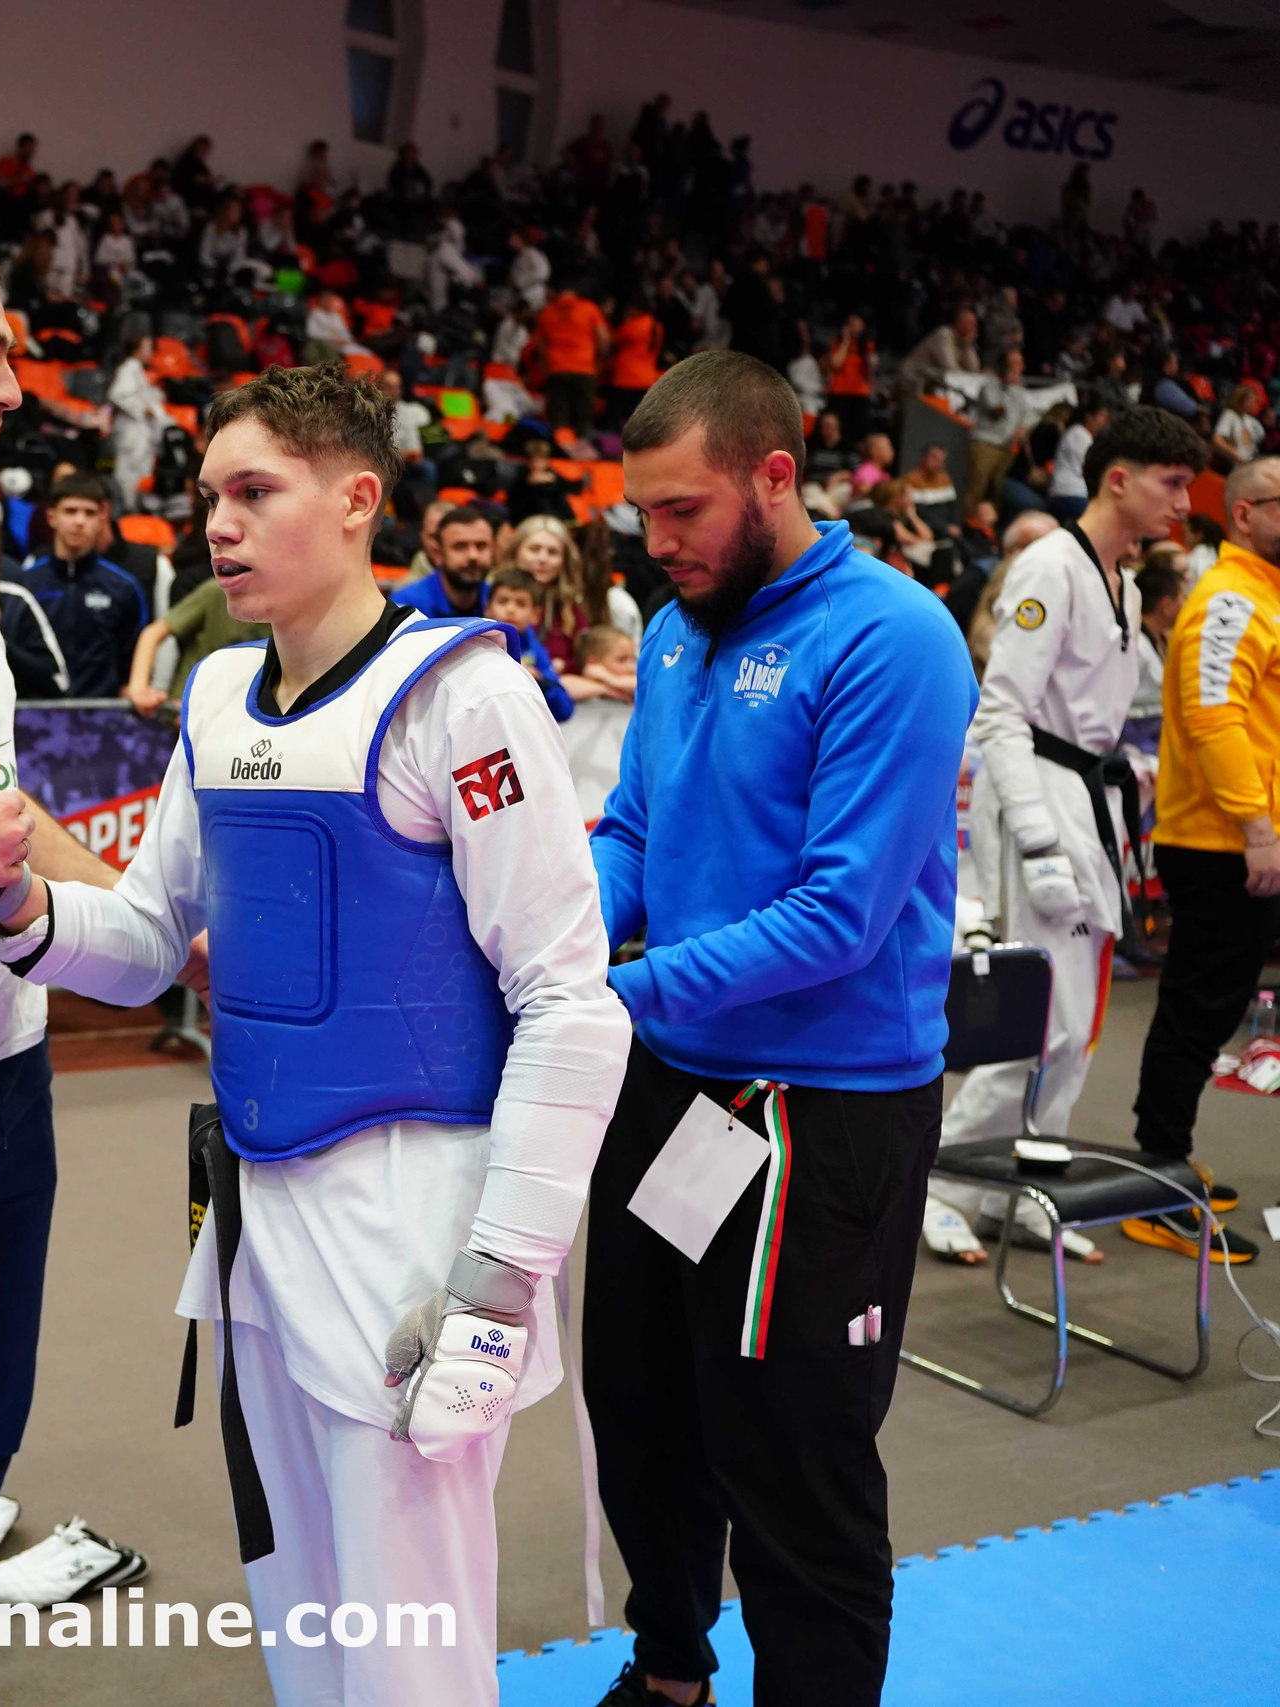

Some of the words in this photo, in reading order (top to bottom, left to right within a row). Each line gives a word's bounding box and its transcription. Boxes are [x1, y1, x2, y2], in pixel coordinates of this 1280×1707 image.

[230, 756, 282, 781] Daedo
[66, 796, 158, 863] PE
[243, 1098, 259, 1131] 3
[470, 1334, 511, 1359] Daedo
[479, 1381, 494, 1393] G3
